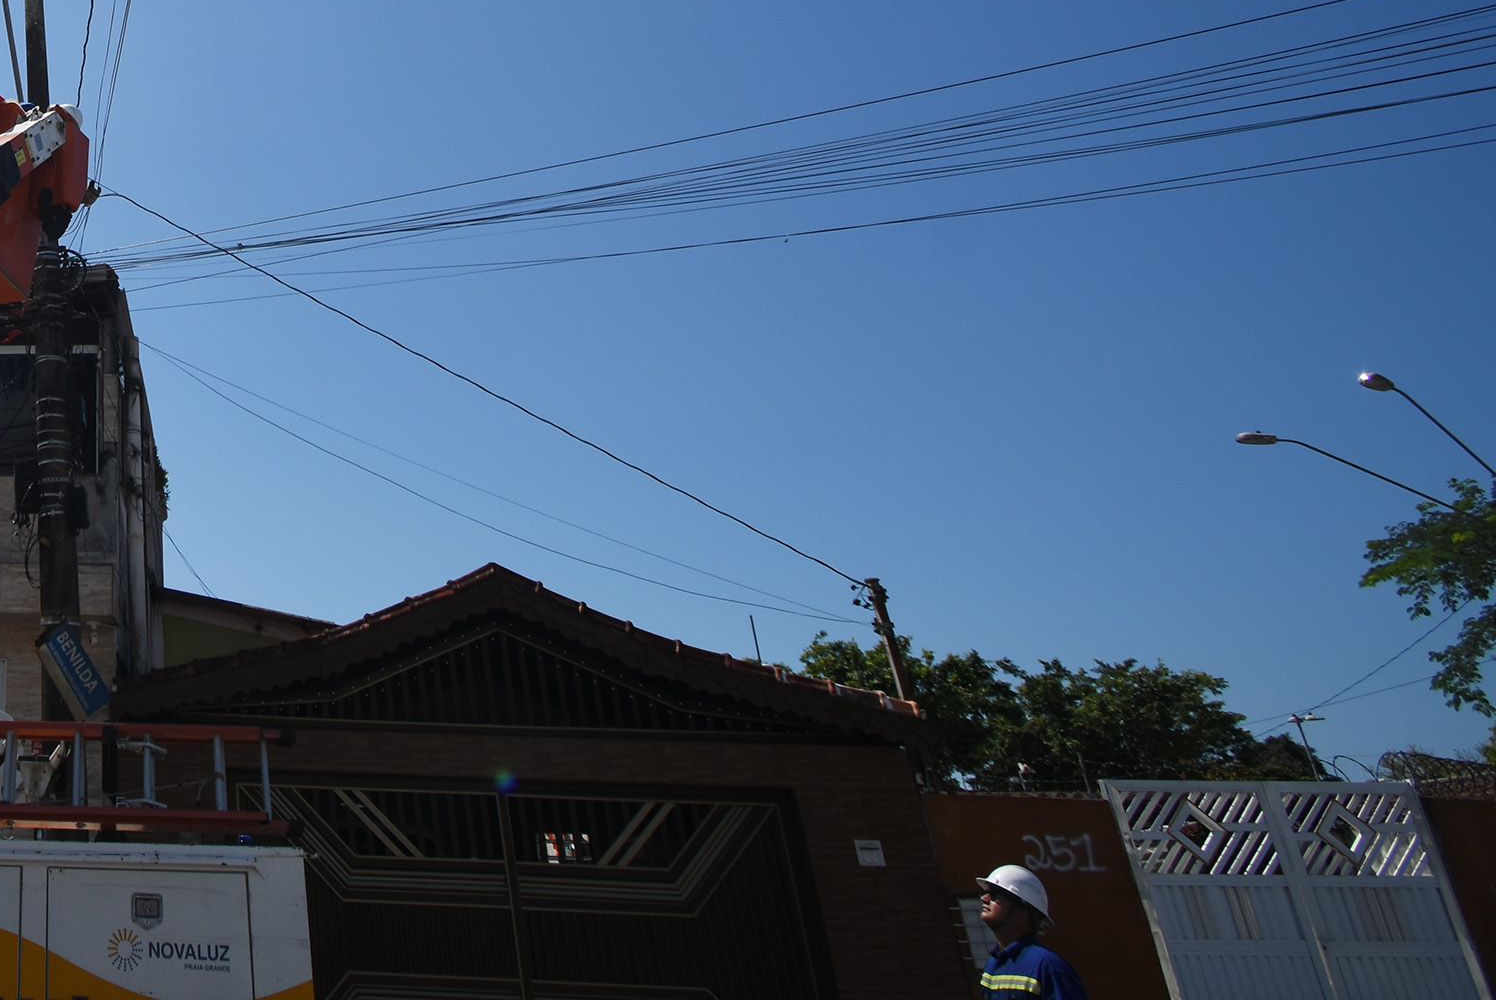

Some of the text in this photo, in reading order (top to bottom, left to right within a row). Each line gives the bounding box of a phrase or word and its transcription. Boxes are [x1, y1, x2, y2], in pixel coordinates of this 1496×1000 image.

[56, 631, 99, 695] BENILDA
[1021, 832, 1108, 872] 251
[148, 942, 231, 962] NOVALUZ
[184, 963, 231, 973] PRAIA GRANDE
